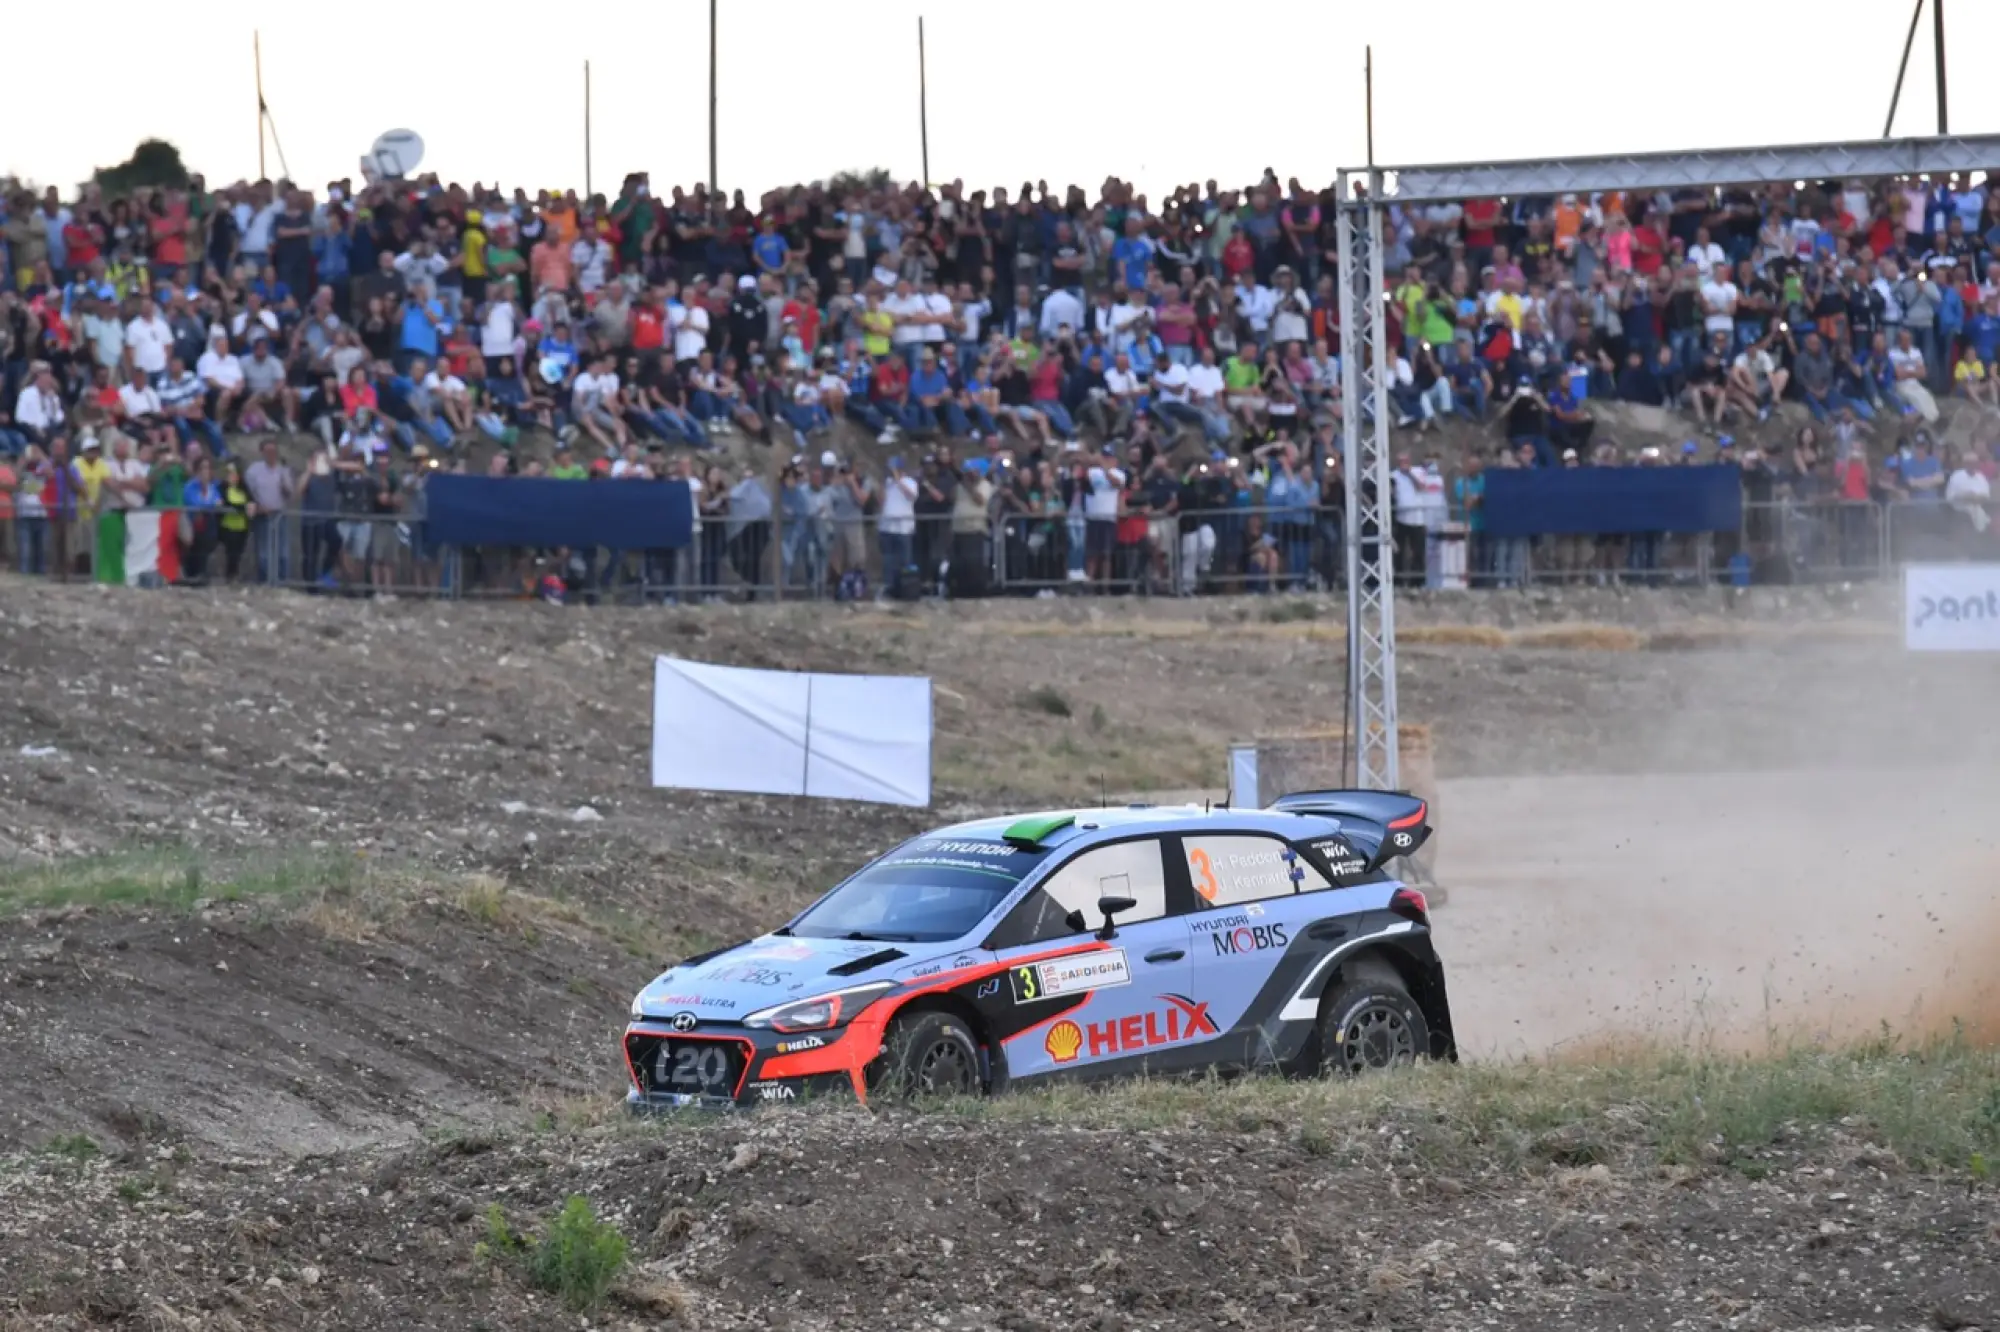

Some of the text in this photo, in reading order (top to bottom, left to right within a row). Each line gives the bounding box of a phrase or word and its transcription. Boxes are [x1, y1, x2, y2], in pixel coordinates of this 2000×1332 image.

[937, 842, 1018, 857] HYUNDAI
[1229, 850, 1282, 868] Paddon
[1190, 848, 1218, 901] 3
[1232, 868, 1289, 890] Kennard
[1190, 915, 1249, 932] HYUNDAI
[1212, 923, 1289, 957] MOBIS
[1060, 962, 1124, 980] SARDEGNA
[1019, 967, 1036, 999] 3
[701, 998, 737, 1009] ULTRA
[1087, 993, 1221, 1056] HELIX
[787, 1035, 825, 1051] HELIX
